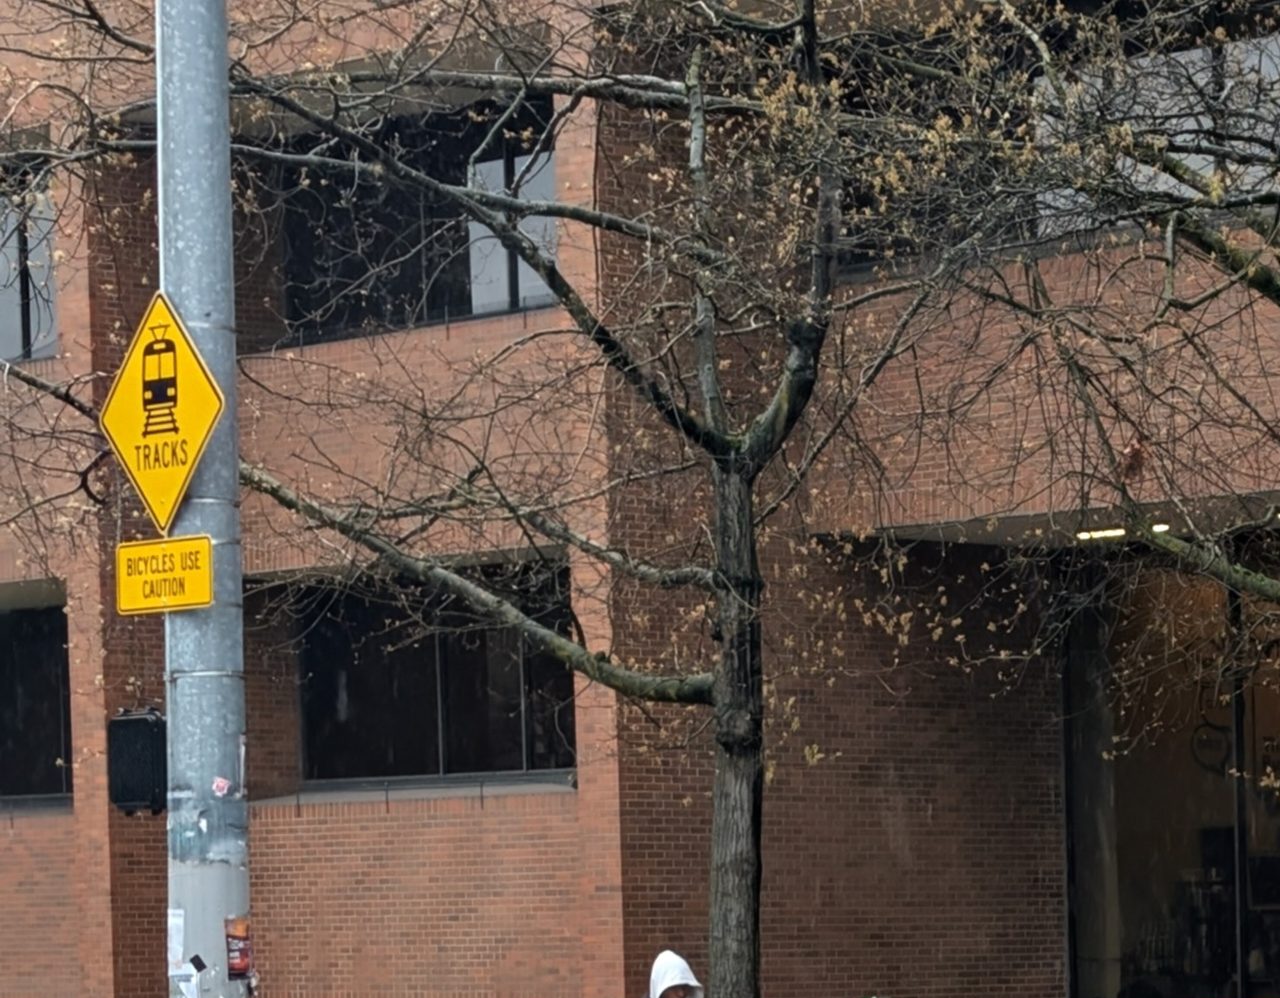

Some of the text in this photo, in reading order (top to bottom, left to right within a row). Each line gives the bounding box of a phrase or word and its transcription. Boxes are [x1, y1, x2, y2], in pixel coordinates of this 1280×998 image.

[134, 439, 189, 472] TRACKS
[126, 550, 201, 577] BICYCLES USE
[142, 577, 186, 600] CAUTION
